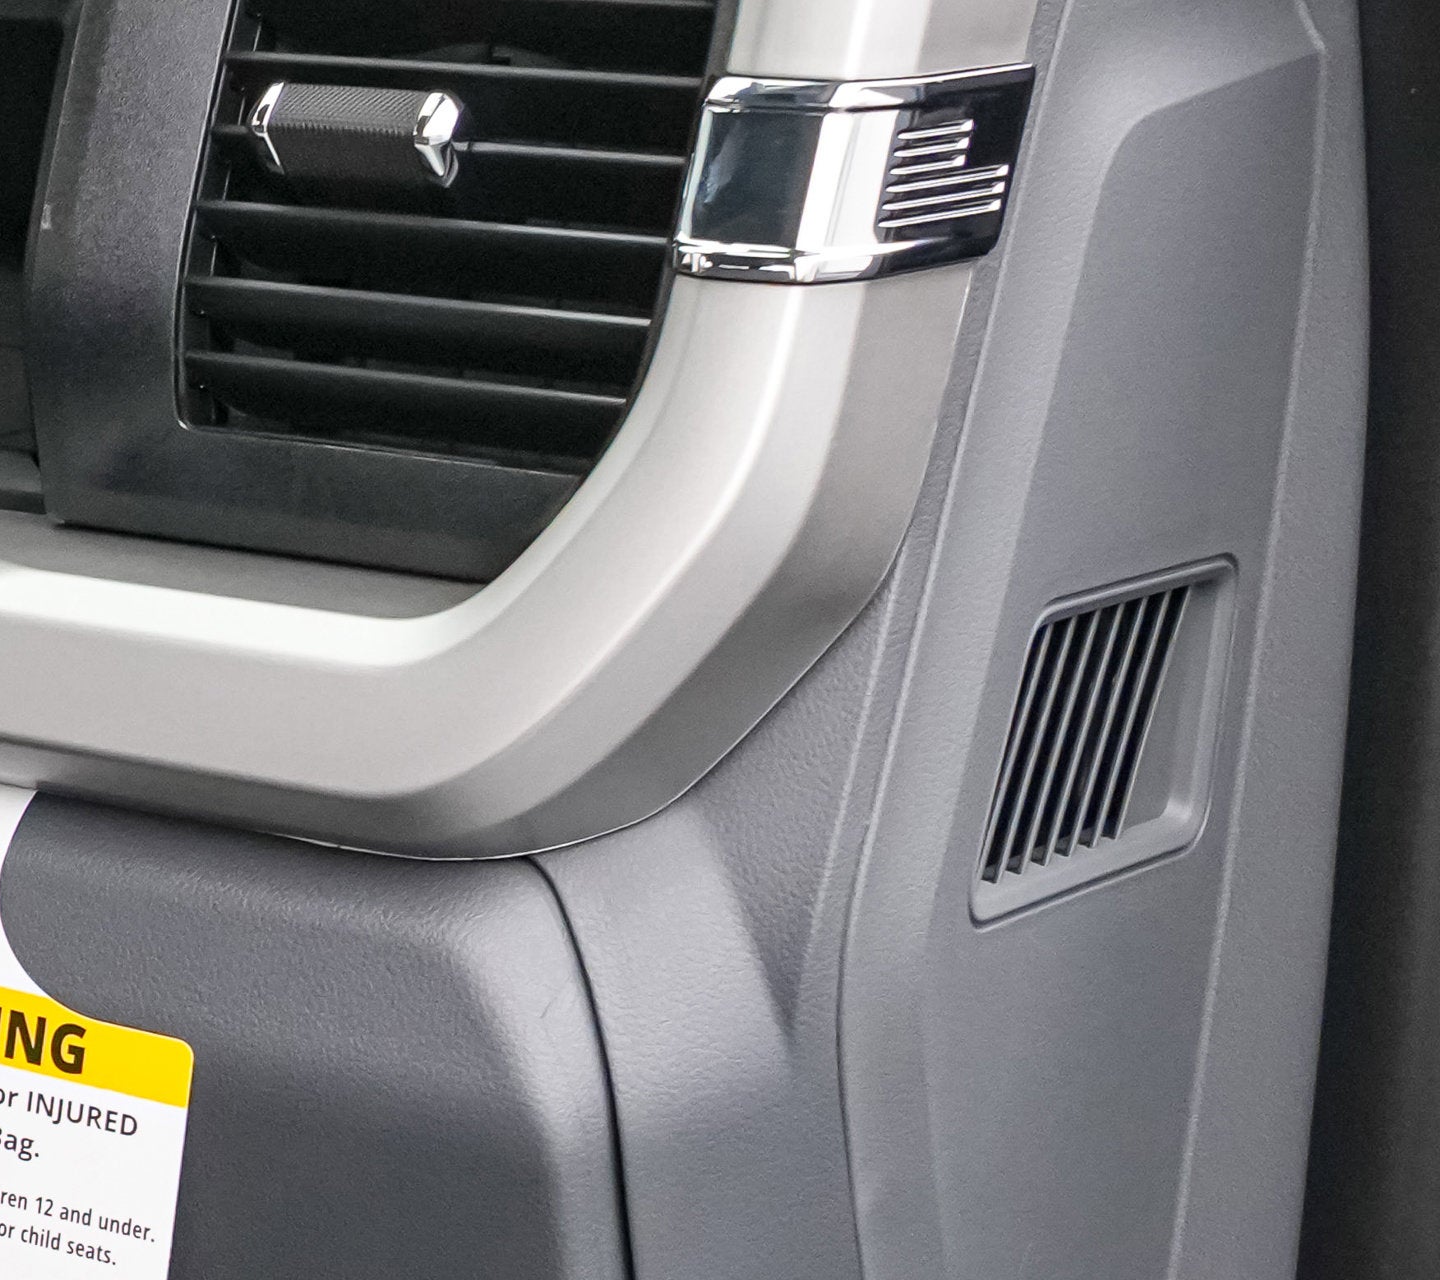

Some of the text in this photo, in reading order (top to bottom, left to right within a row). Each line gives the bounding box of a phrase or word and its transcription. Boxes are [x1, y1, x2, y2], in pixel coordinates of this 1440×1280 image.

[27, 1091, 138, 1136] INJURED
[35, 1196, 54, 1217] 12
[59, 1206, 92, 1226] and
[98, 1216, 155, 1243] under.
[20, 1225, 61, 1251] child
[66, 1240, 116, 1266] seats.
